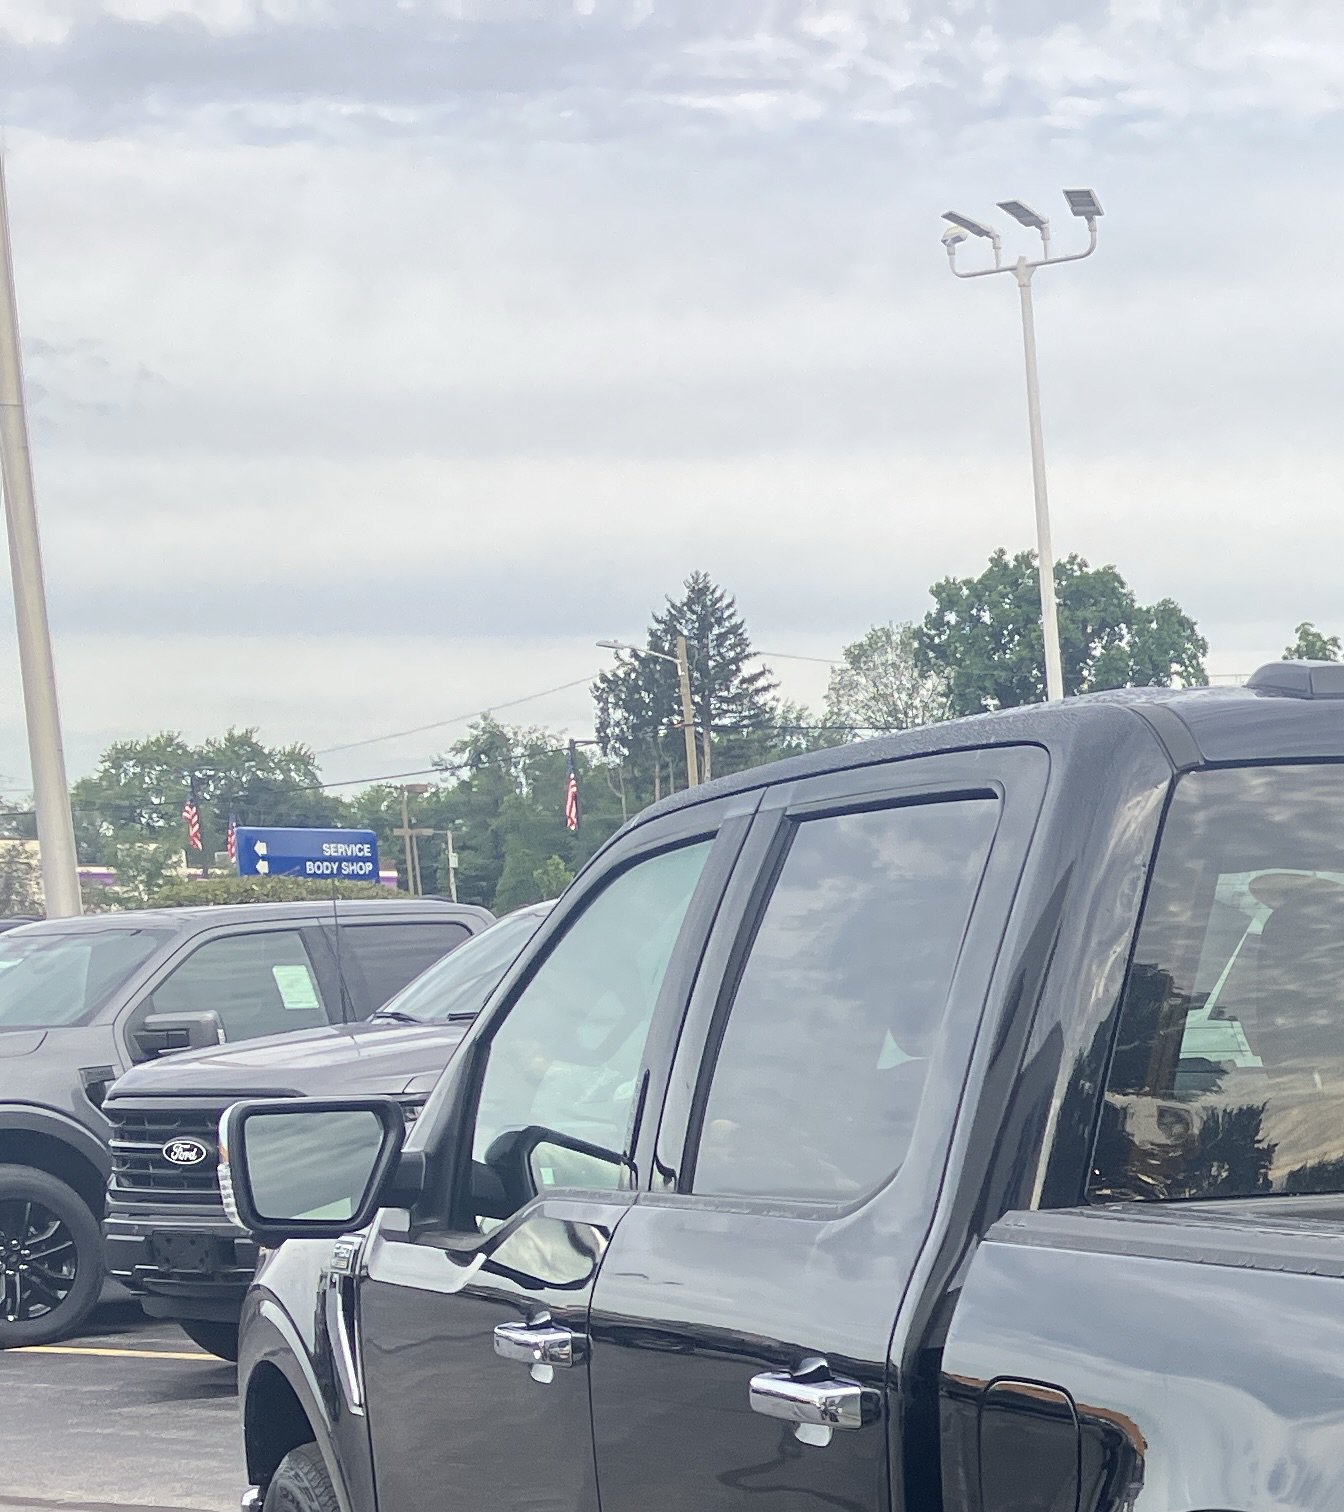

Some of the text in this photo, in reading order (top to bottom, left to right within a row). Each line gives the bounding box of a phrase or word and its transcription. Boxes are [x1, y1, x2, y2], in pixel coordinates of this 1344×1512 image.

[322, 843, 372, 857] SERVICE
[305, 861, 373, 875] BODY SHOP
[171, 1144, 198, 1160] Ford
